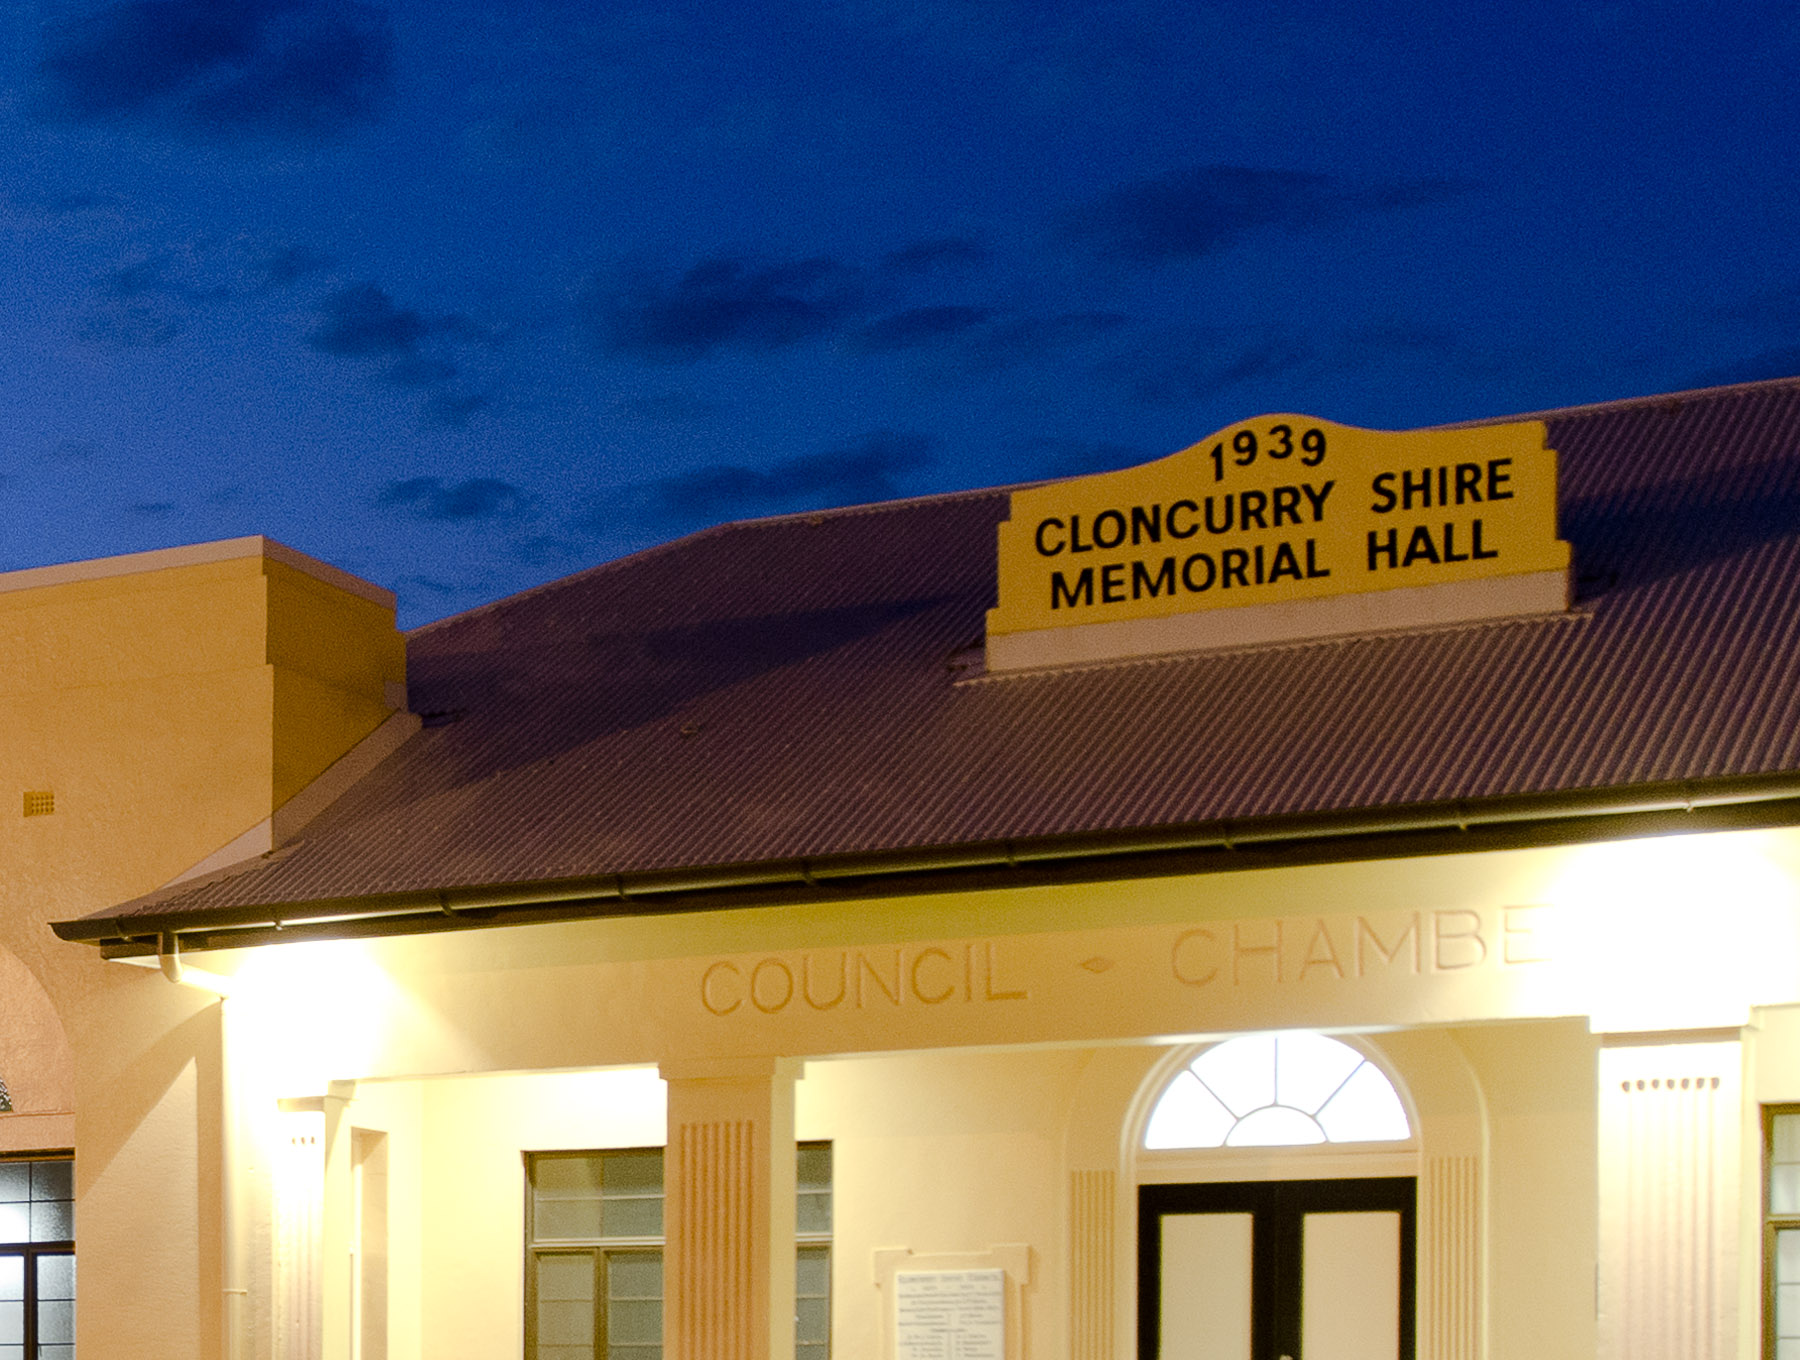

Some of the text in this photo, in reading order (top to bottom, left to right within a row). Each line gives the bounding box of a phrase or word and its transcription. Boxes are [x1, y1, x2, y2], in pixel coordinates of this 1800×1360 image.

[1211, 424, 1327, 481] 1939
[1034, 458, 1514, 557] CLONCURRY SHIRE
[1050, 519, 1498, 609] MEMORIAL HALL
[700, 904, 1552, 1017] COUNCIL CHAMBE
